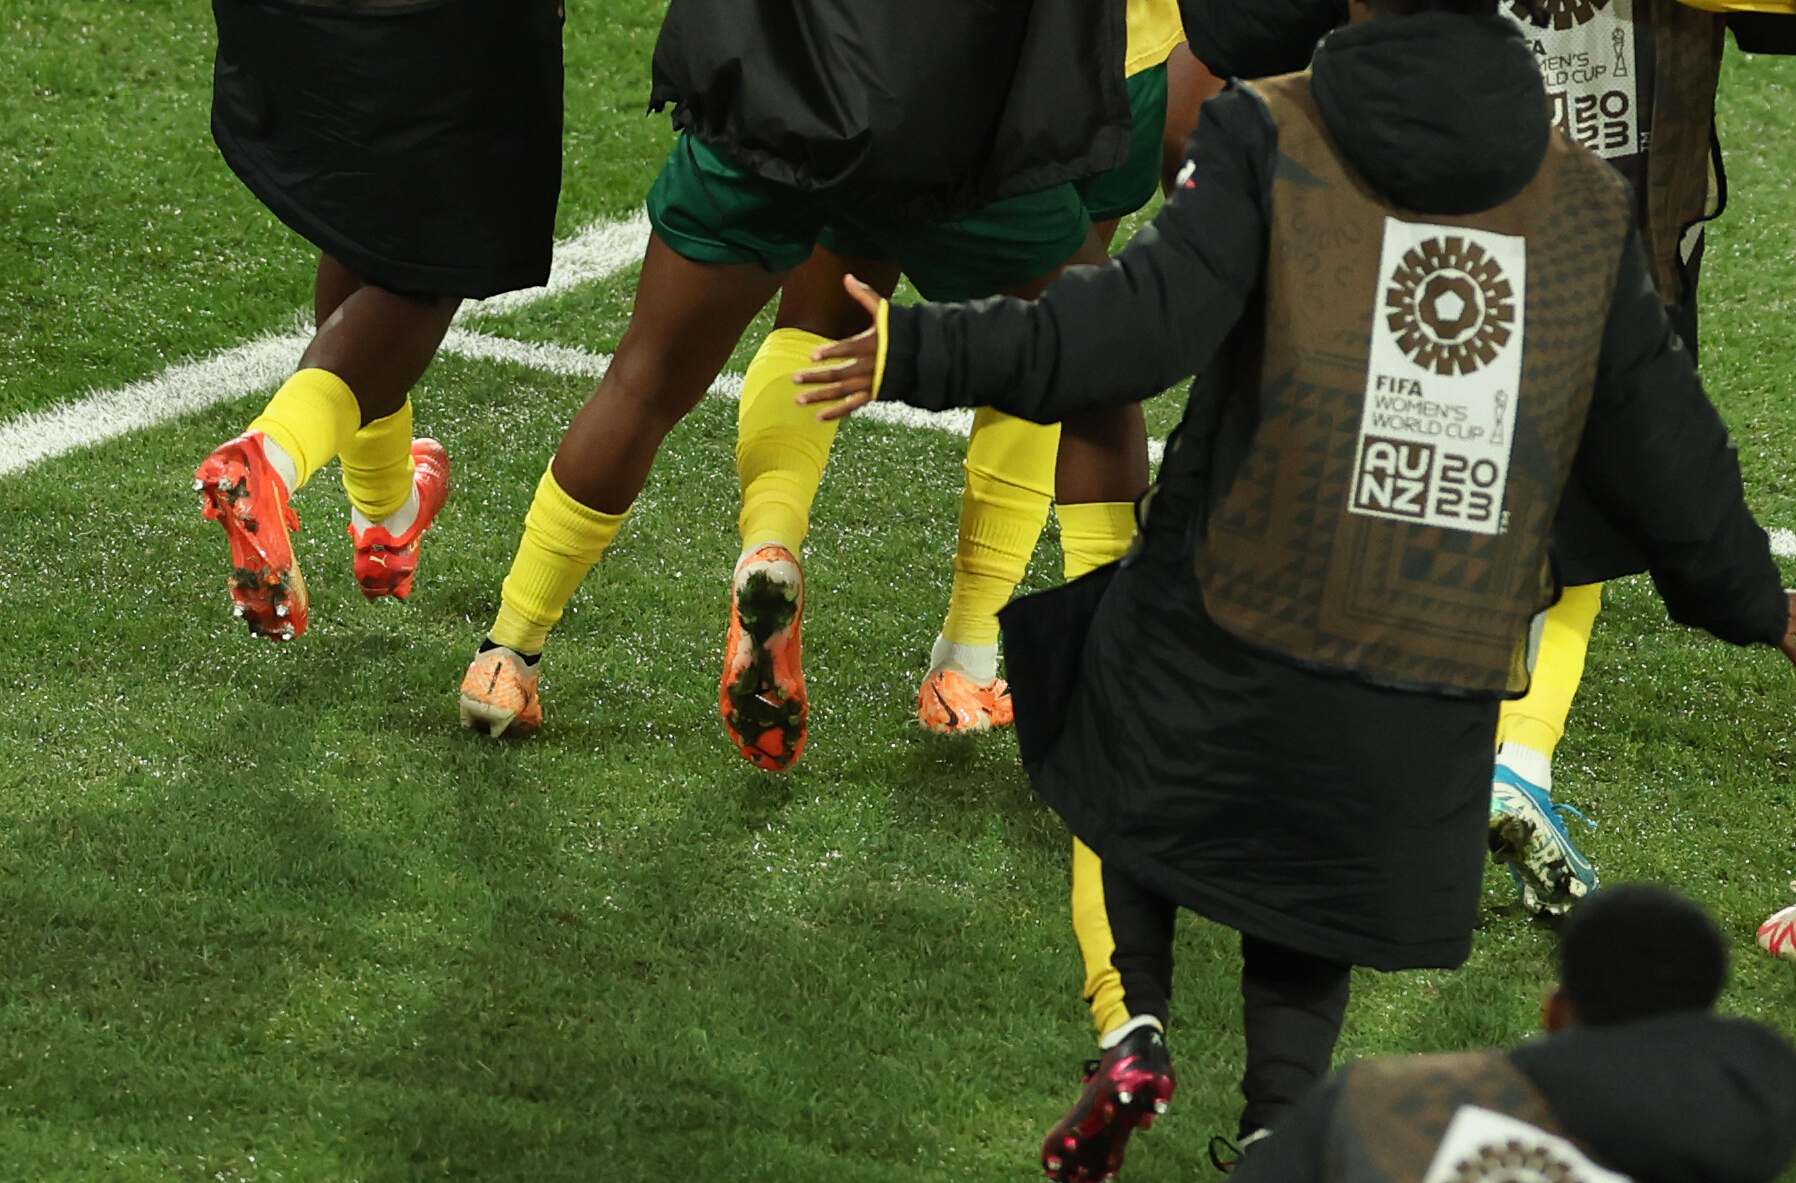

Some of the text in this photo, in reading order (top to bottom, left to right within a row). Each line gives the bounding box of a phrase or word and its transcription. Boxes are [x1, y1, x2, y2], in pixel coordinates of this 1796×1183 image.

[1572, 65, 1607, 84] CUP
[1574, 90, 1629, 125] 20
[1376, 374, 1423, 397] FIFA
[1375, 395, 1468, 422] WOMEN'S
[1372, 413, 1485, 440] WORLD CUP
[1364, 441, 1430, 479] AU
[1441, 453, 1498, 488] 20
[1360, 473, 1425, 513] NZ
[1435, 486, 1493, 521] 23
